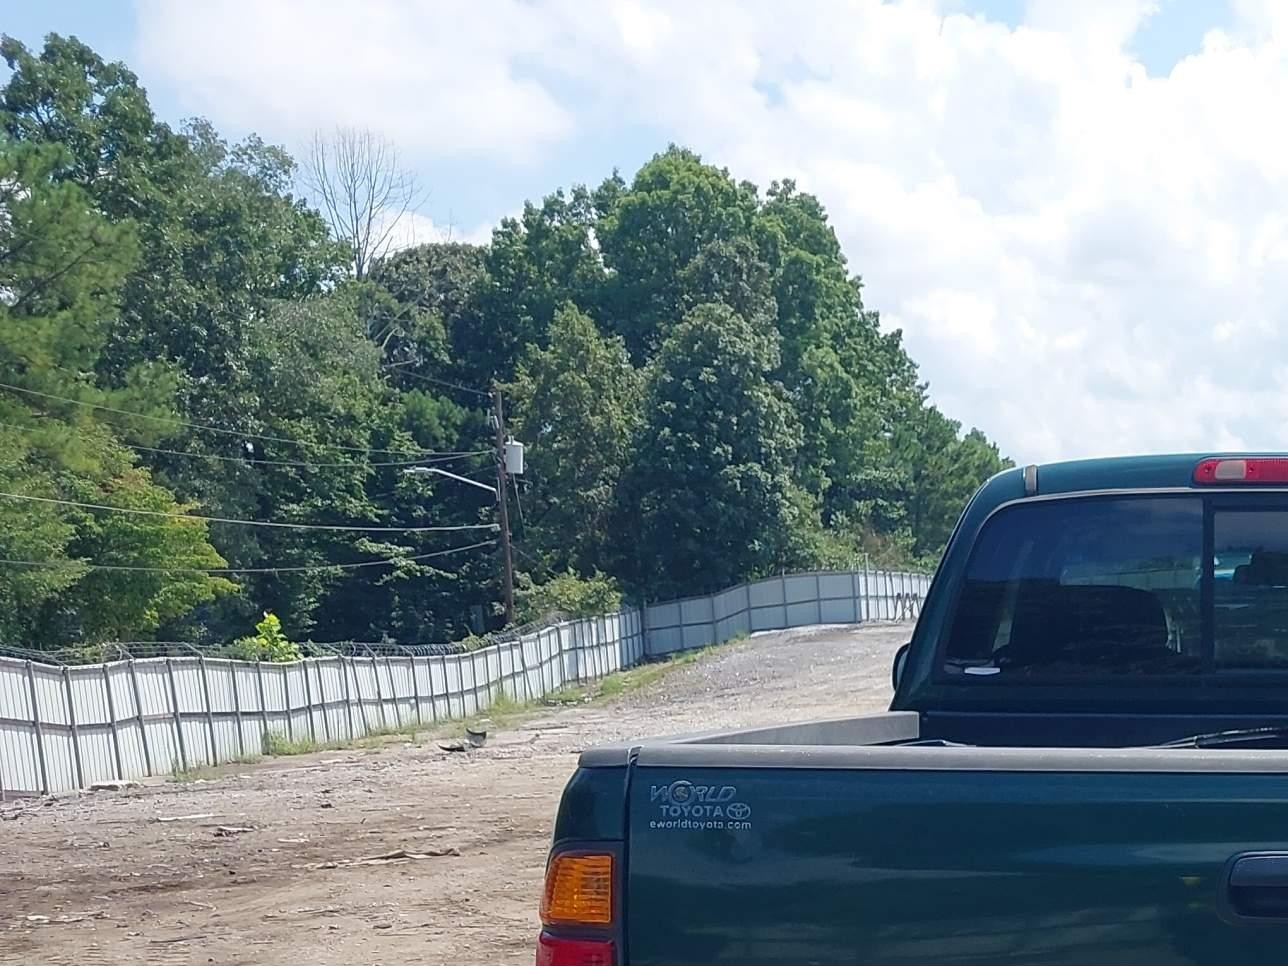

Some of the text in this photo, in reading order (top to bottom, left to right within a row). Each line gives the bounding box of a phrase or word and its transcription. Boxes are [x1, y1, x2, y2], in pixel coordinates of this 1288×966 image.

[650, 780, 737, 806] WORLD
[660, 805, 724, 817] TOYOTA
[649, 819, 752, 830] eworldtoyota.com
